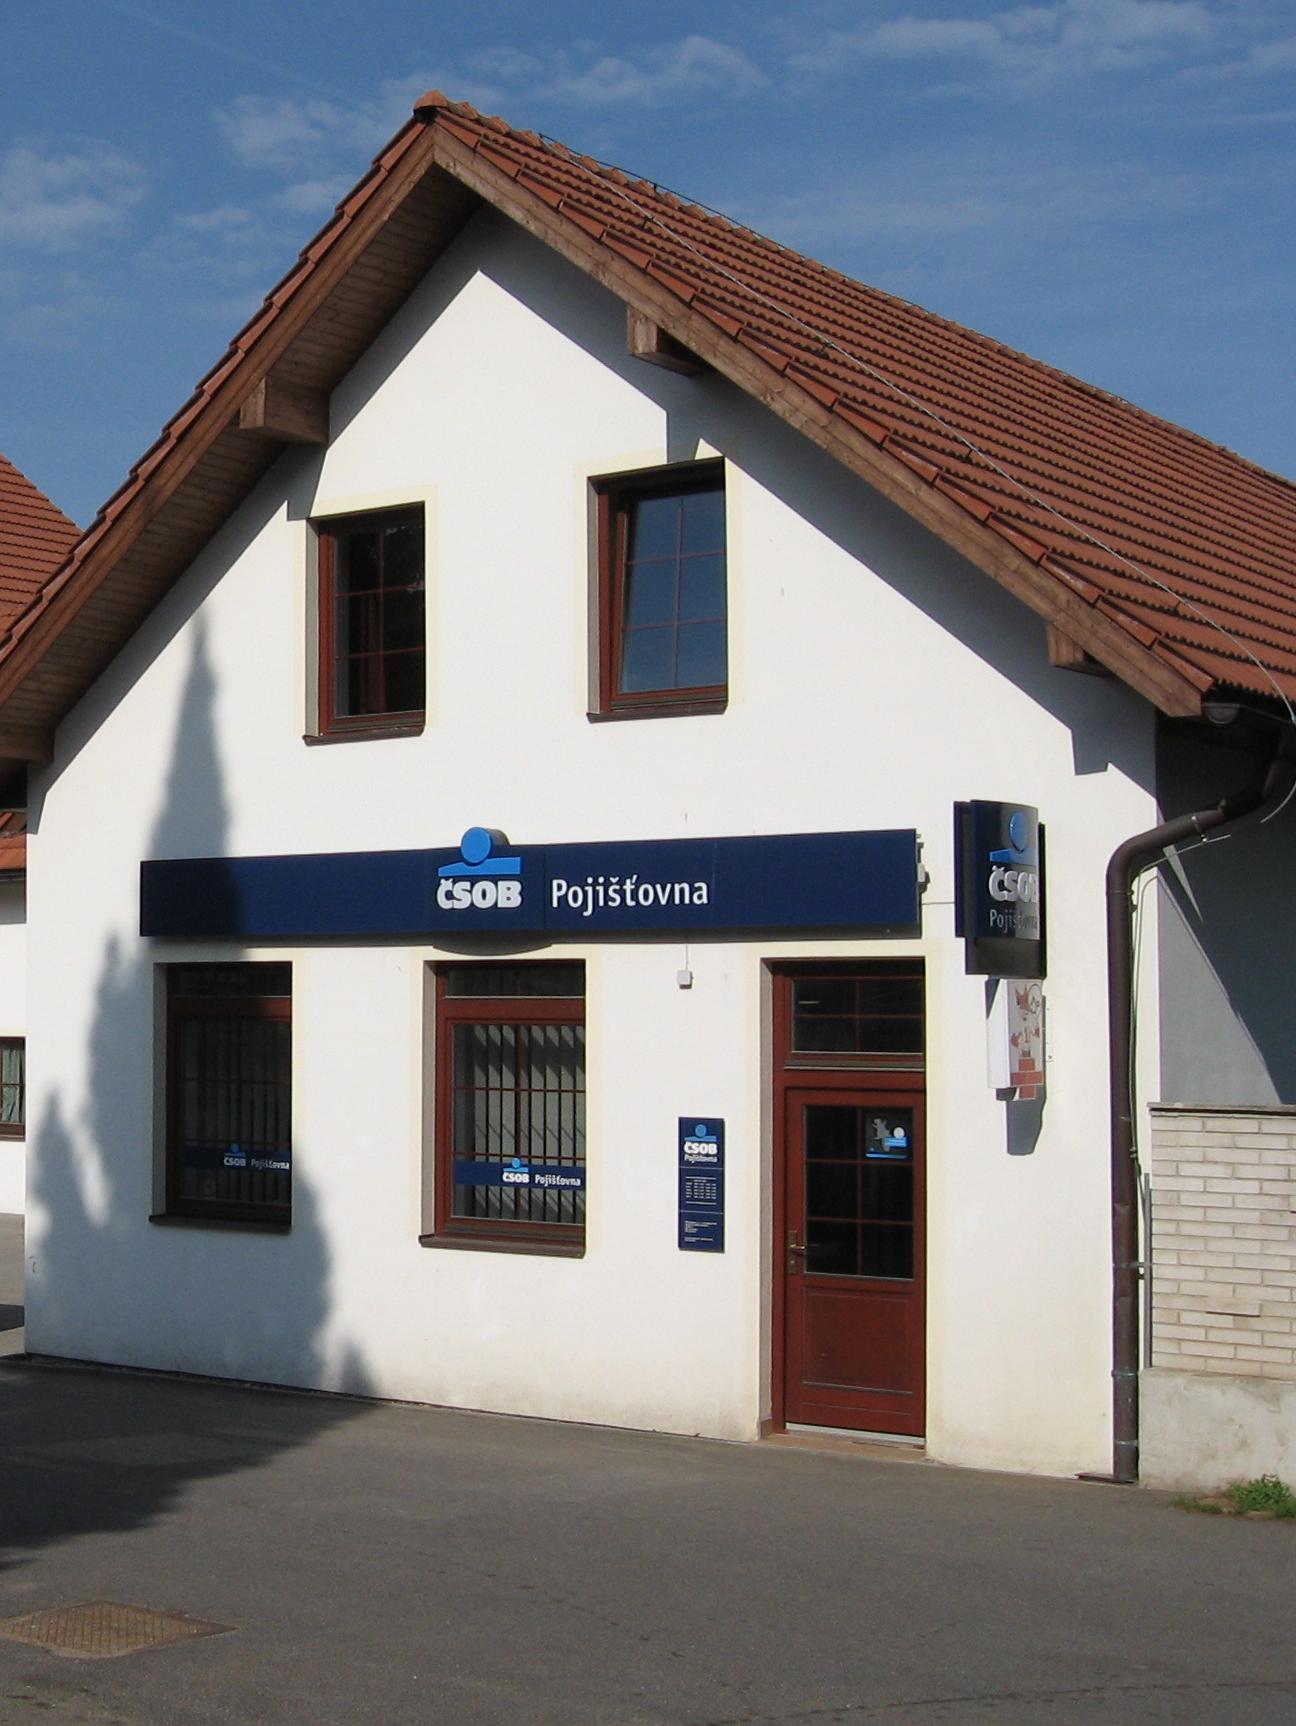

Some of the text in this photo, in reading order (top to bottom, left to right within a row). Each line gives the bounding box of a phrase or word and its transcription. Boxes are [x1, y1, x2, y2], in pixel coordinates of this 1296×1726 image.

[437, 875, 709, 916] ČSOB Pojišťovna
[684, 1141, 718, 1155] ČSOB
[502, 1172, 581, 1187] ČSOB Pojišťovna
